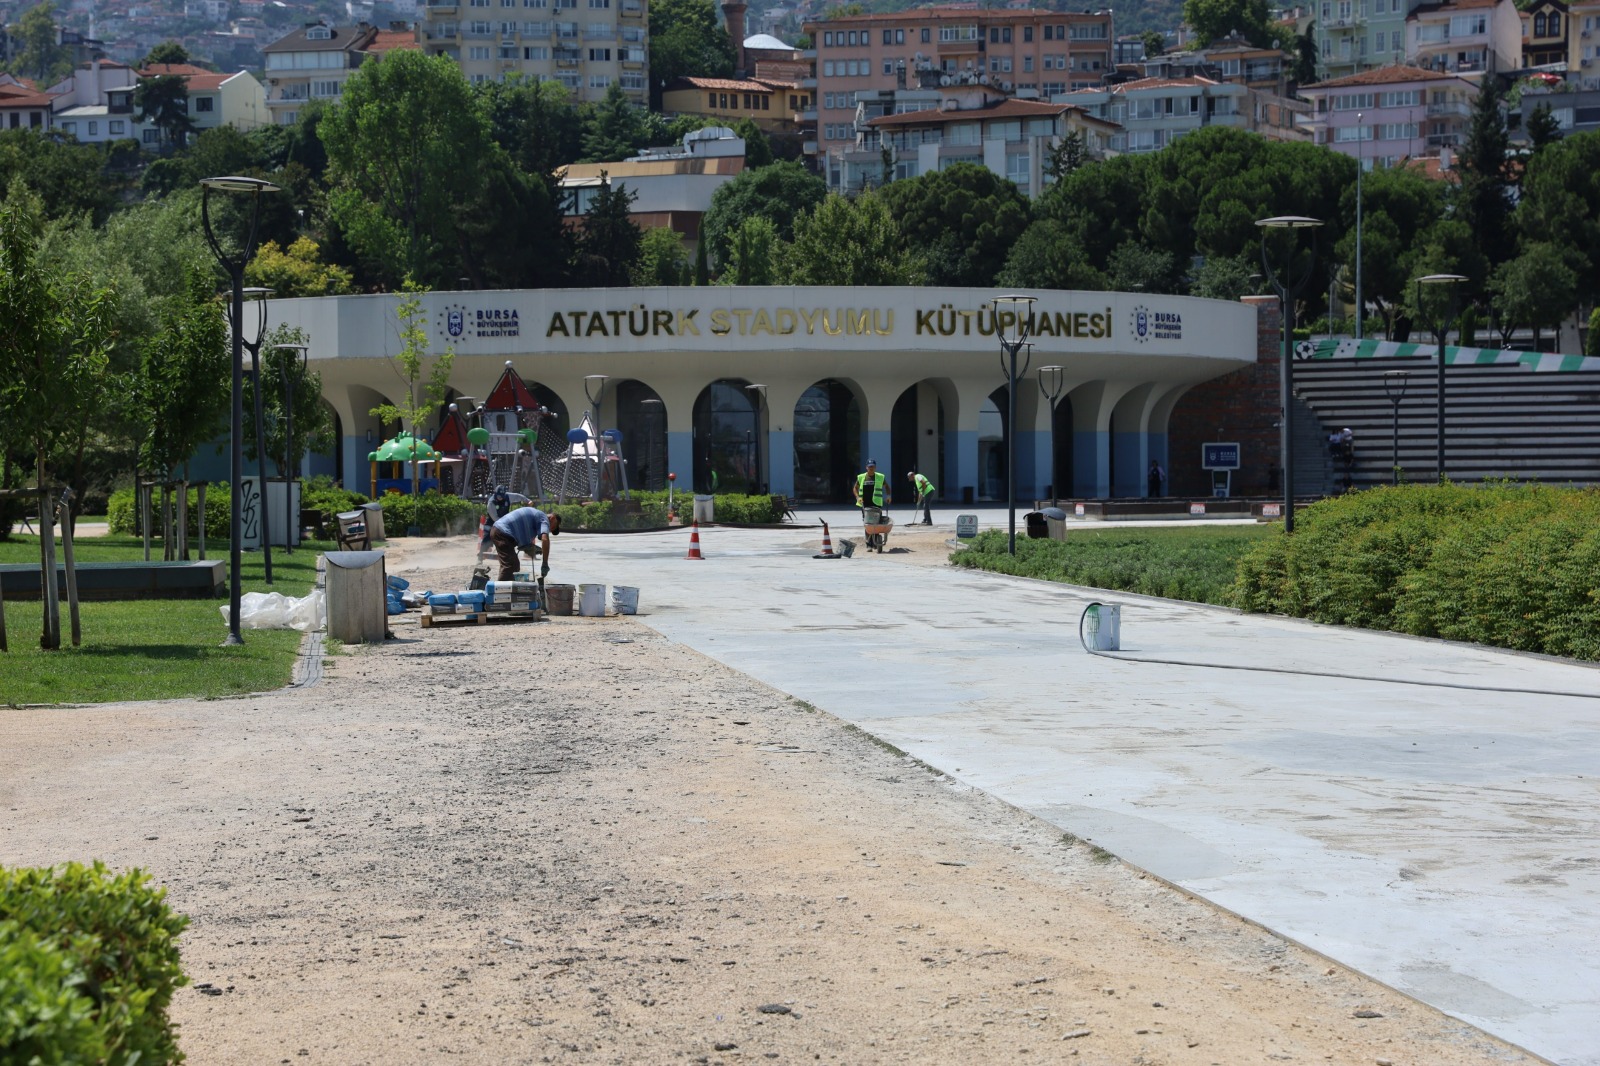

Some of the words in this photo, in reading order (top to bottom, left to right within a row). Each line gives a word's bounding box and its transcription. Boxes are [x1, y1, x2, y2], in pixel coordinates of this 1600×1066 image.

[476, 309, 519, 320] BURSA
[1155, 312, 1182, 323] BURSA
[546, 304, 699, 337] ATATÜRK
[710, 308, 894, 336] STADYUMU
[915, 304, 1112, 338] KÜTÜPHANESİ
